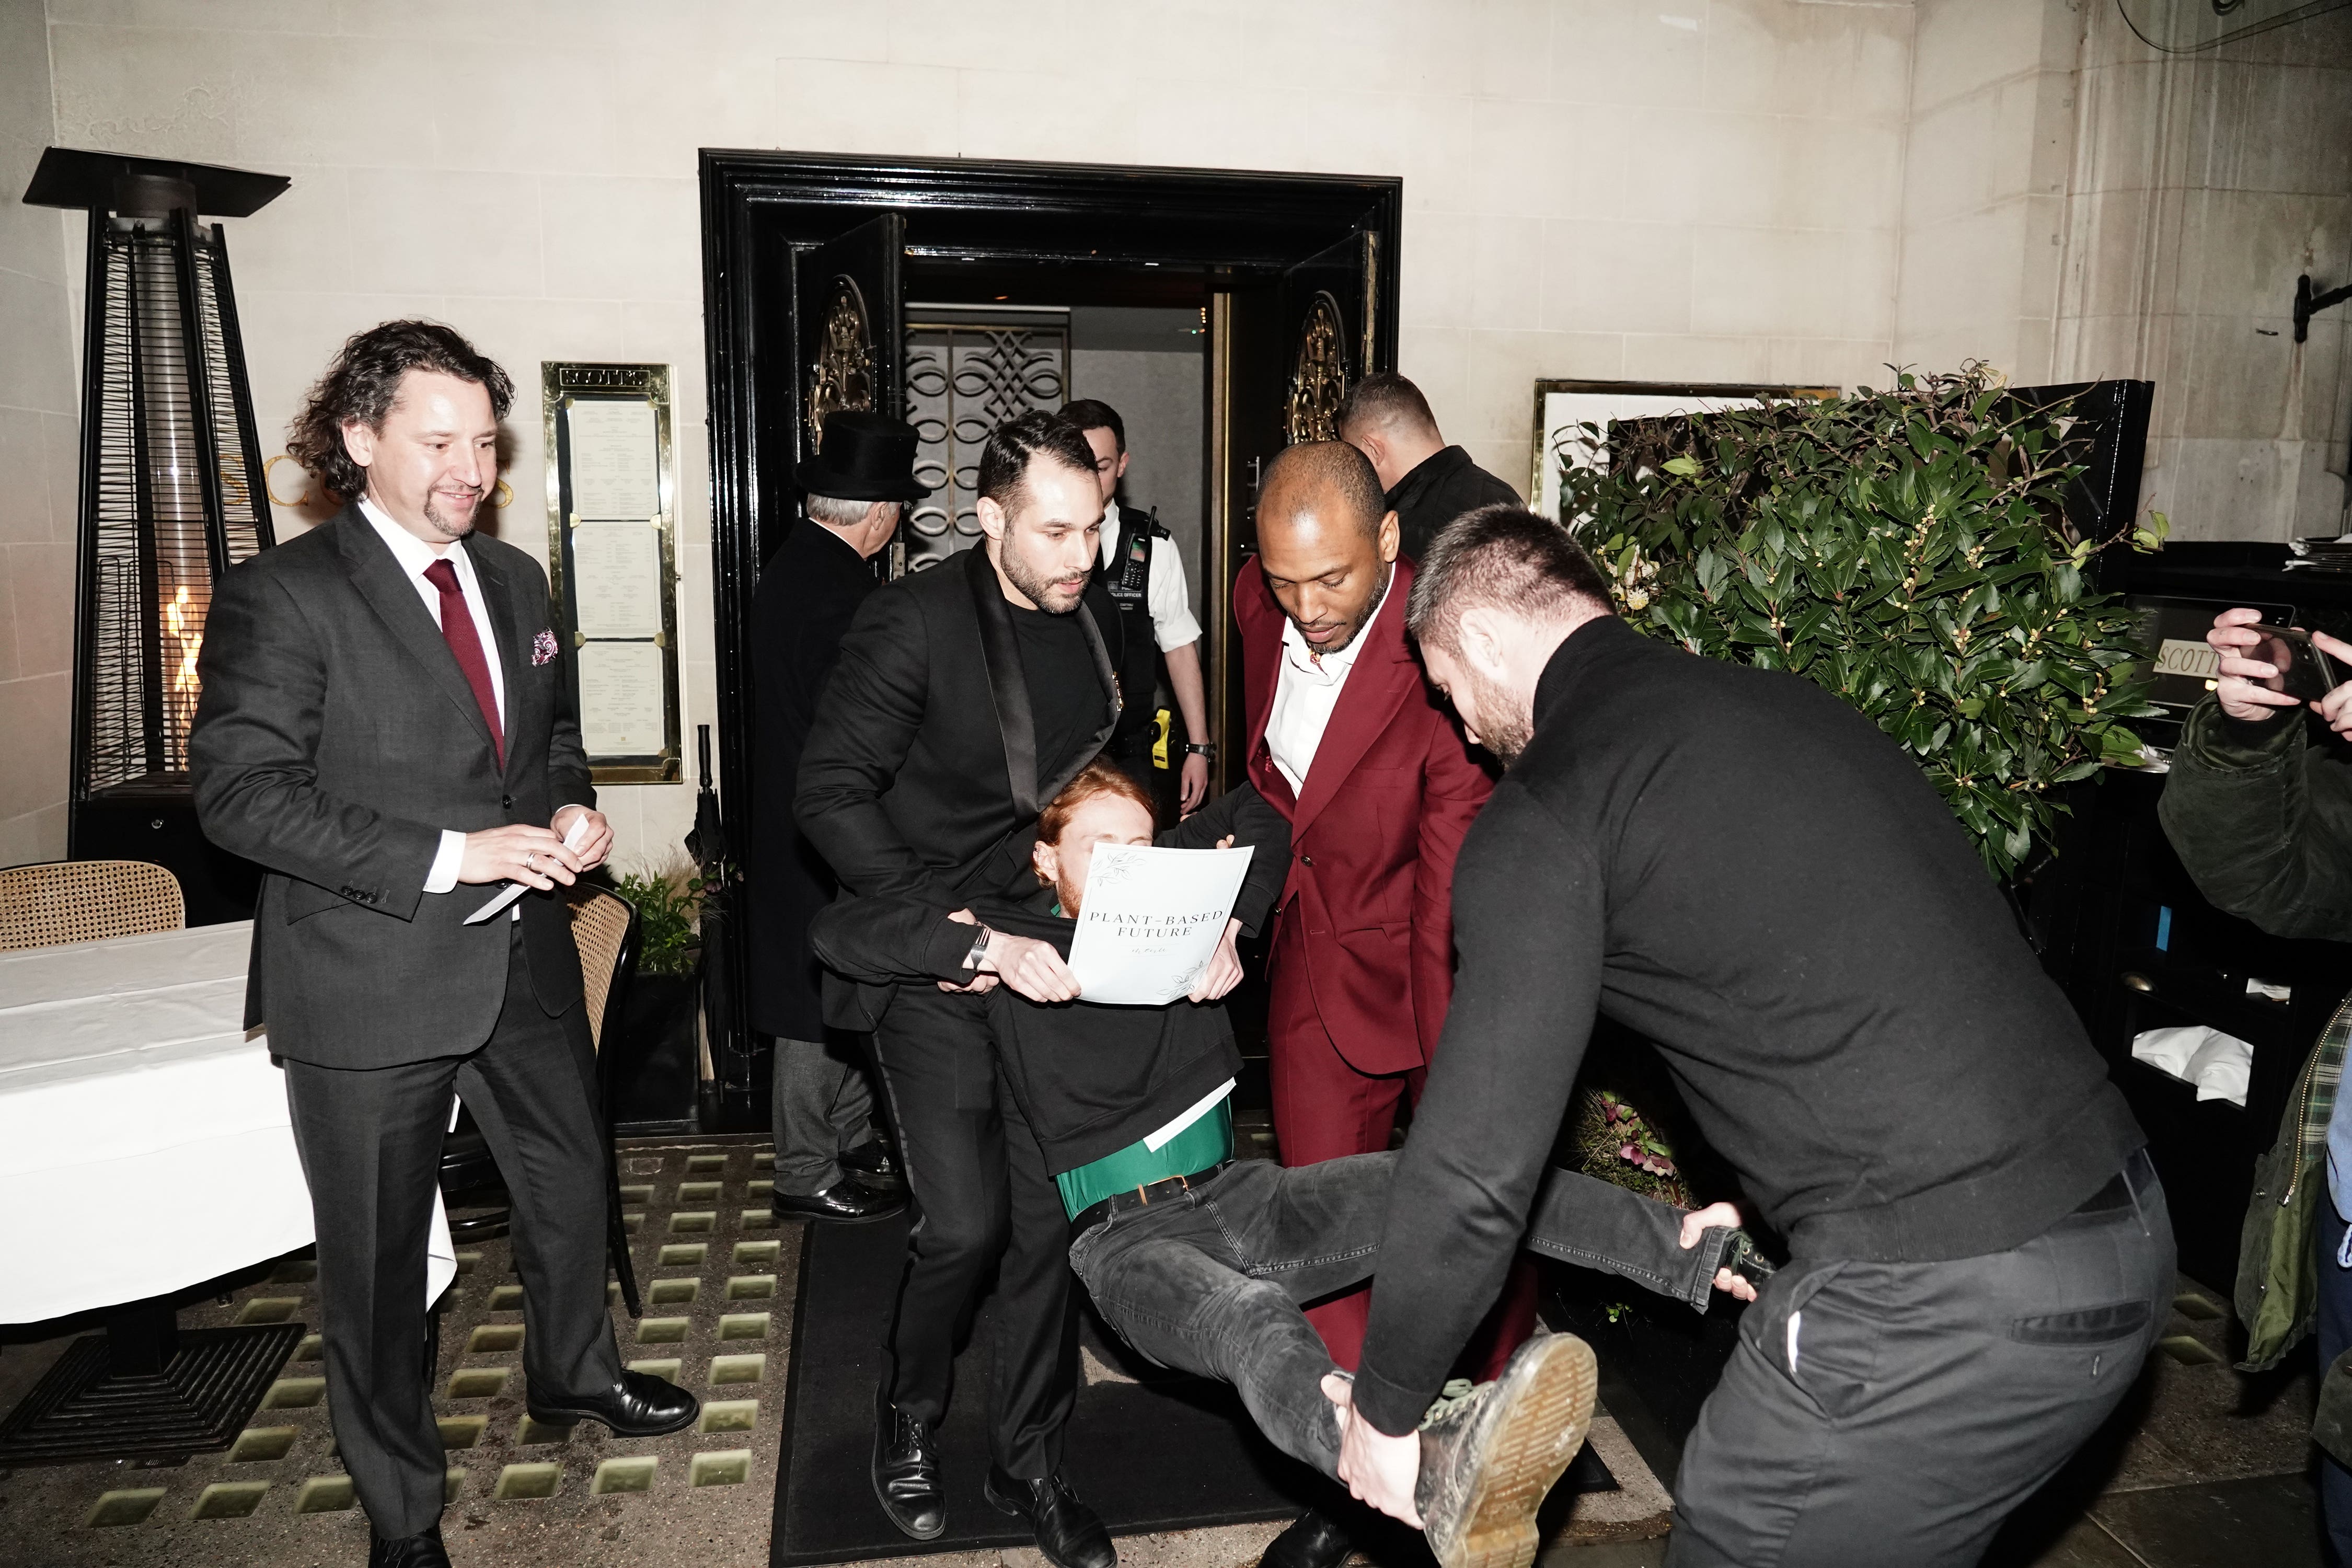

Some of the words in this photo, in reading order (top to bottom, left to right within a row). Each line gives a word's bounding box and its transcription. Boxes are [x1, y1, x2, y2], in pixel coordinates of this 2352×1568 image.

[565, 369, 643, 385] SCOTT'S
[1090, 910, 1223, 925] PLANT-BASED
[1117, 927, 1192, 938] FUTURE
